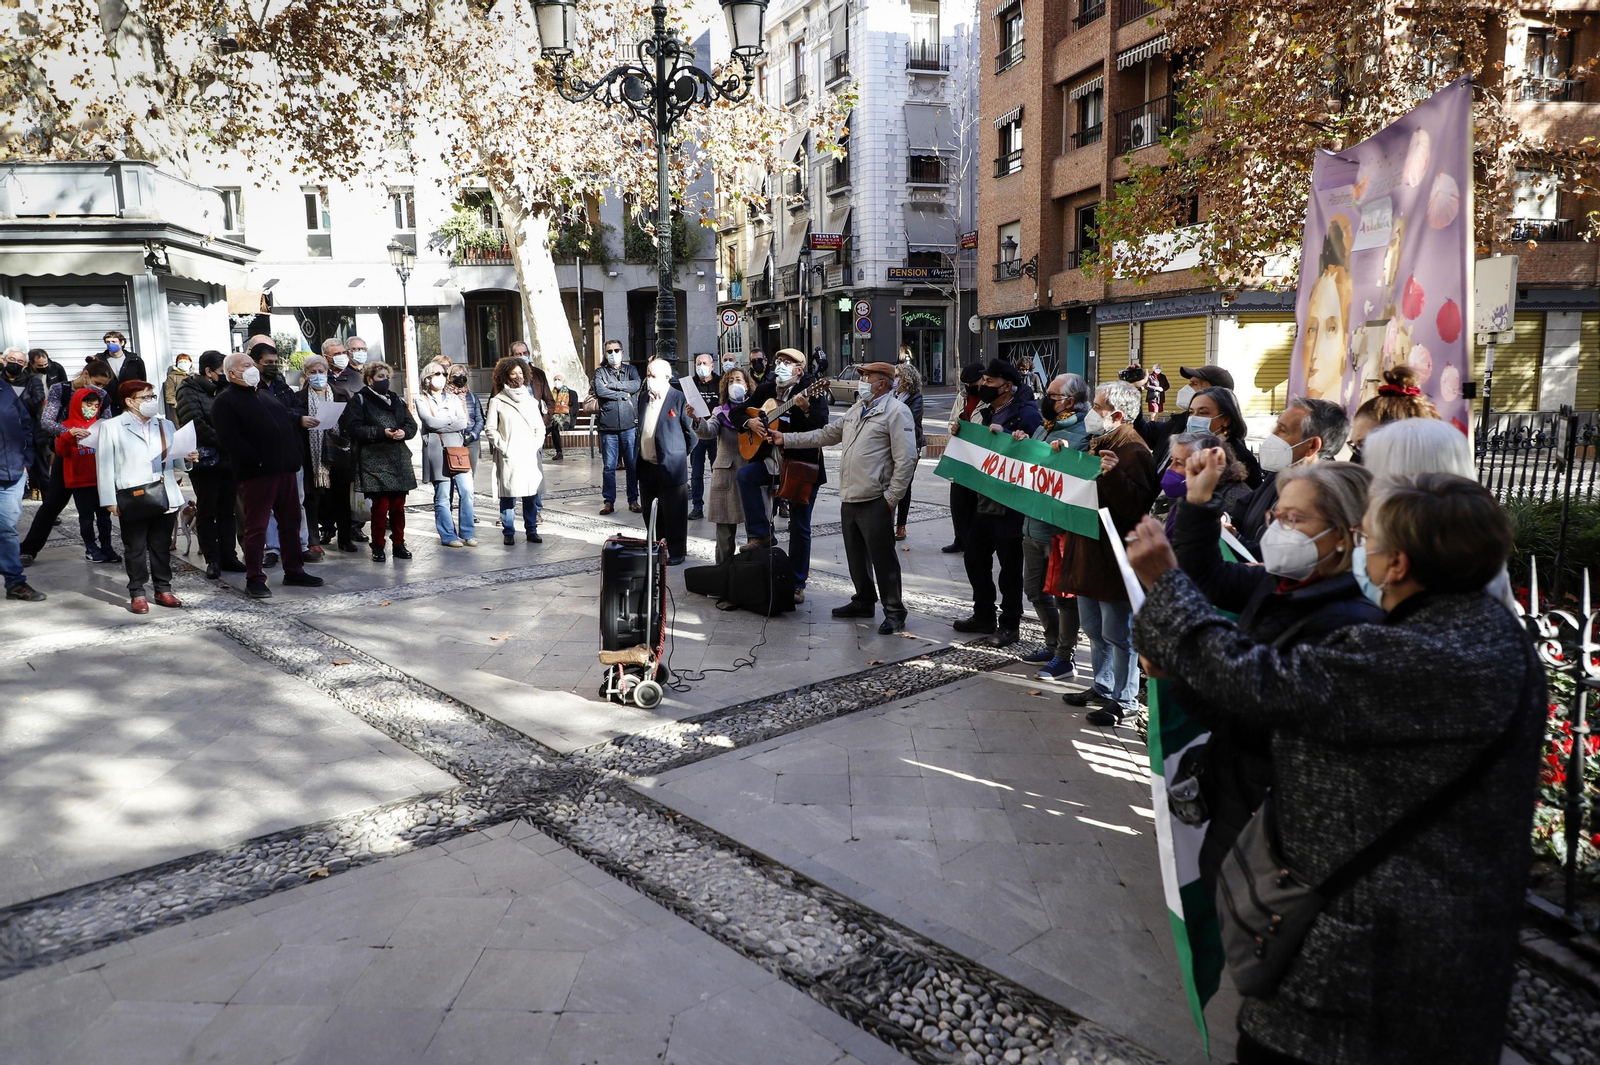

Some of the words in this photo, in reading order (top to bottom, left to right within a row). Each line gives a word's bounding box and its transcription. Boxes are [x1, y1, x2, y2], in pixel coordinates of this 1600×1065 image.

[890, 268, 928, 277] PENSION
[725, 314, 735, 322] 20
[901, 311, 942, 327] Farmacia
[1101, 309, 1112, 320] LA
[980, 452, 1000, 476] NO
[997, 456, 1006, 481] A
[1009, 460, 1025, 486] LA
[1029, 464, 1064, 500] TOMA
